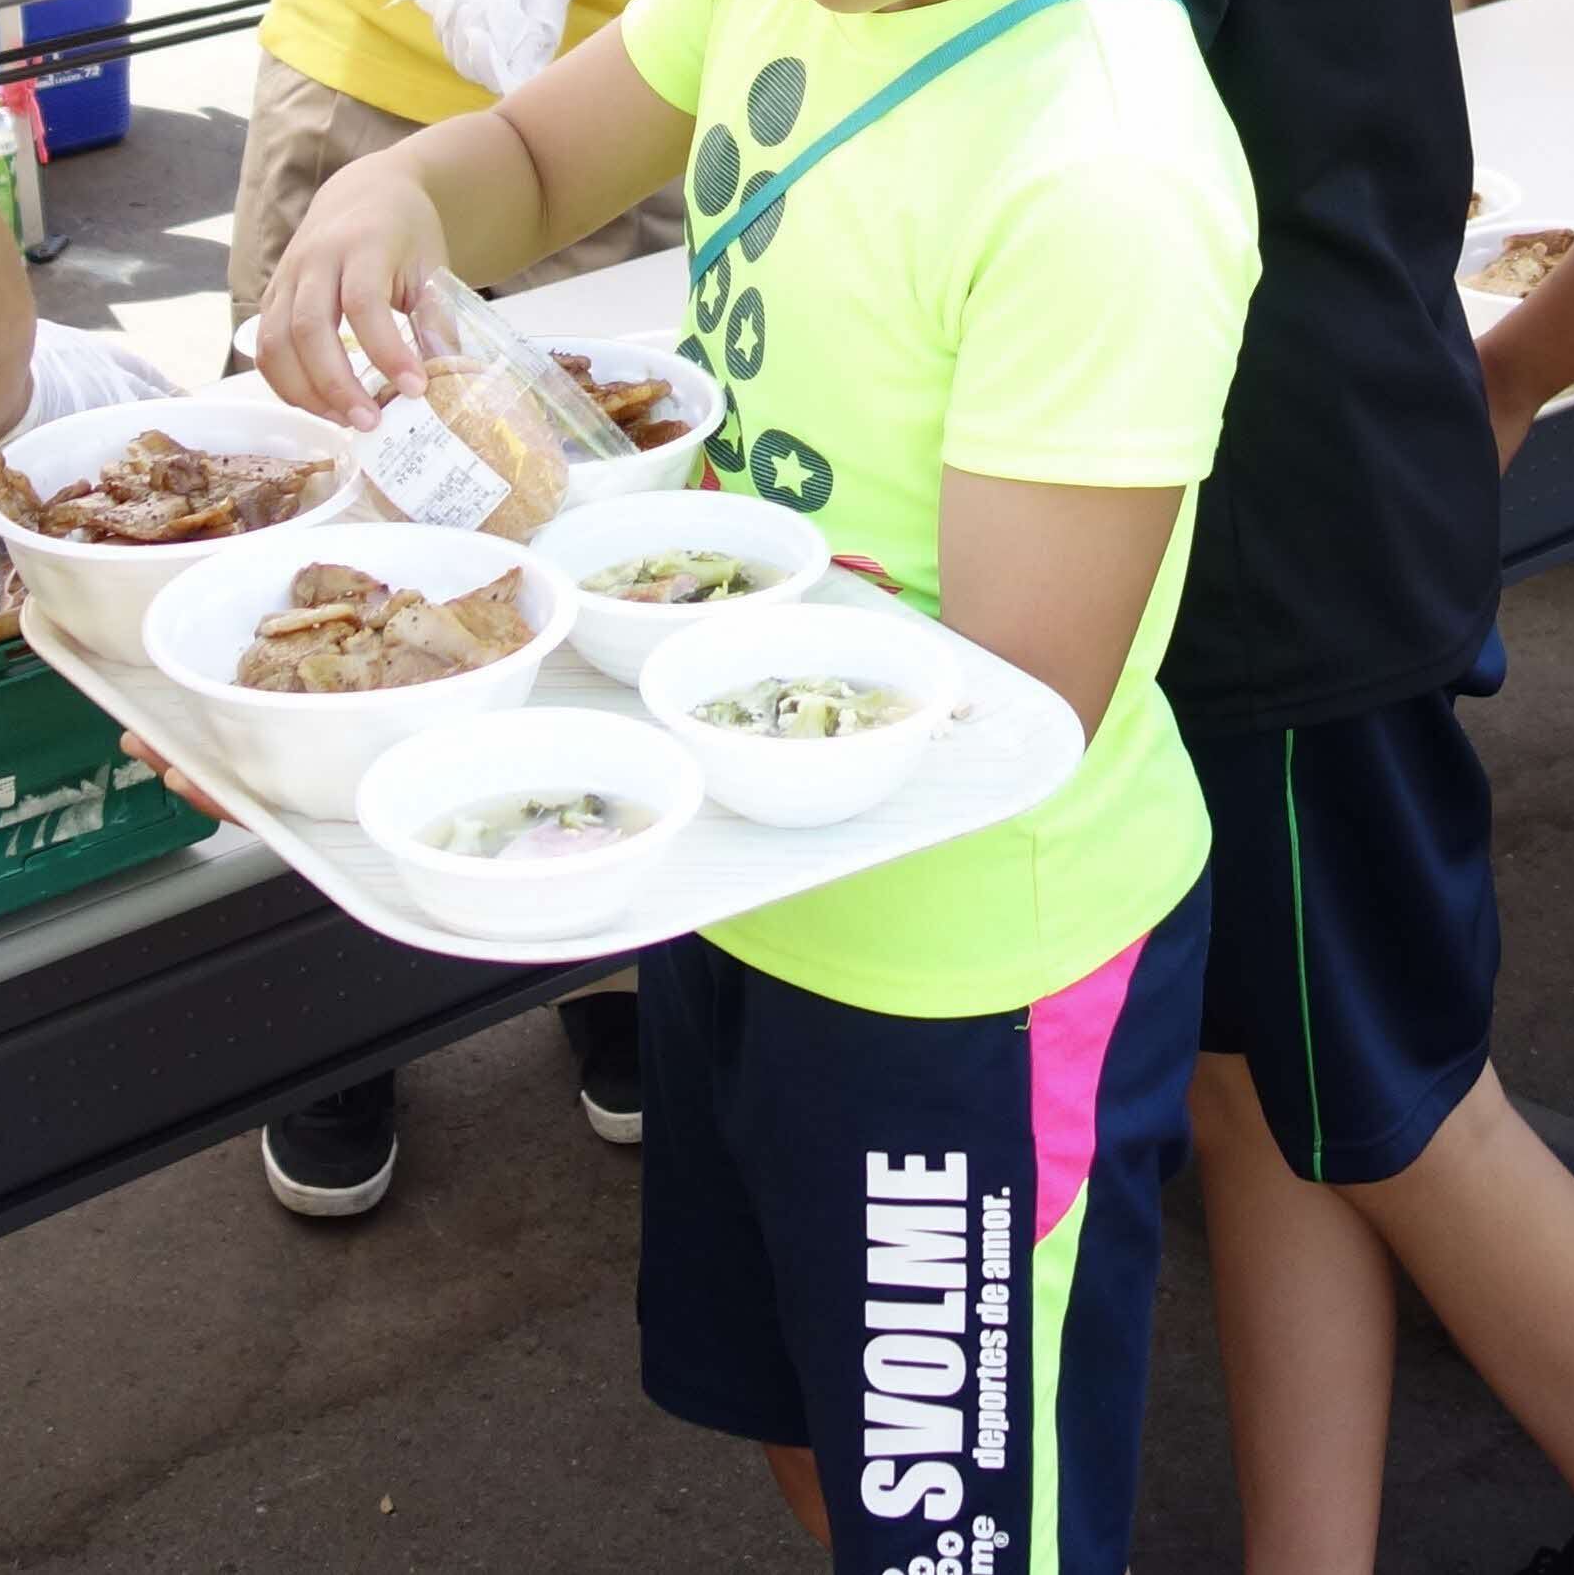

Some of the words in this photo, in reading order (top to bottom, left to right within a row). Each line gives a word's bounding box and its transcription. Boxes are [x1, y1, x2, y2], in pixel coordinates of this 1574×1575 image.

[982, 1186, 1012, 1280] amor.
[860, 1150, 968, 1522] SVOLME
[975, 1283, 1010, 1326] de
[972, 1328, 1009, 1470] deportes
